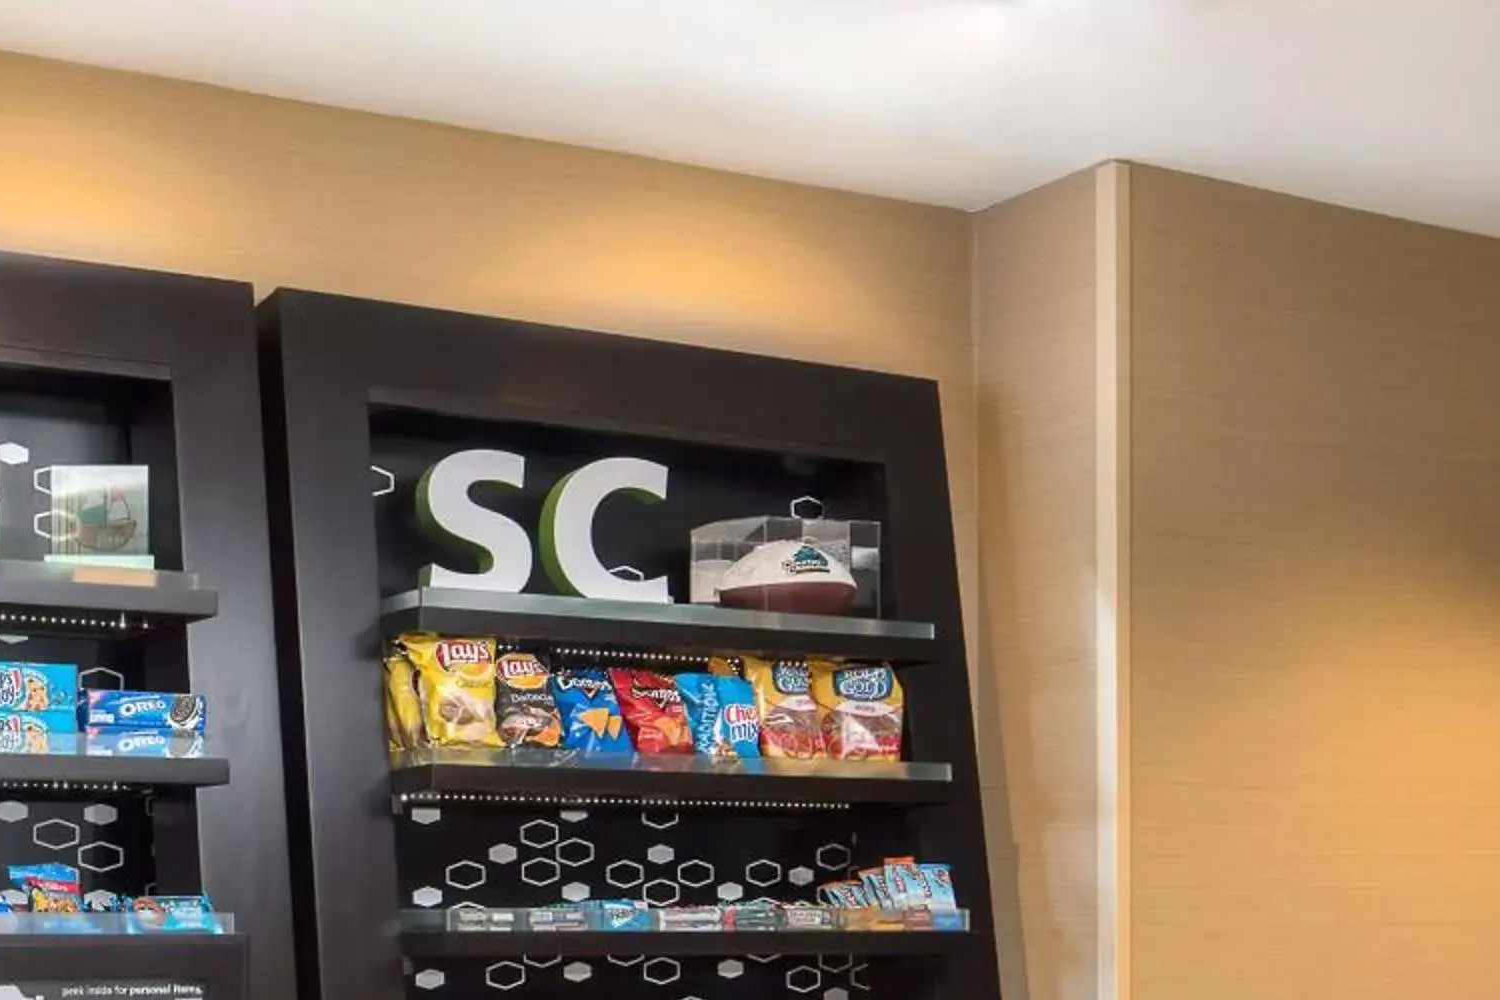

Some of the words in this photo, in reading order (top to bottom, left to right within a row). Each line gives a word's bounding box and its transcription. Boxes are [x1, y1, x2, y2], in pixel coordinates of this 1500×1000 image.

[416, 448, 669, 603] SC
[442, 640, 489, 667] Lay's
[114, 984, 128, 995] for
[129, 983, 171, 997] personal
